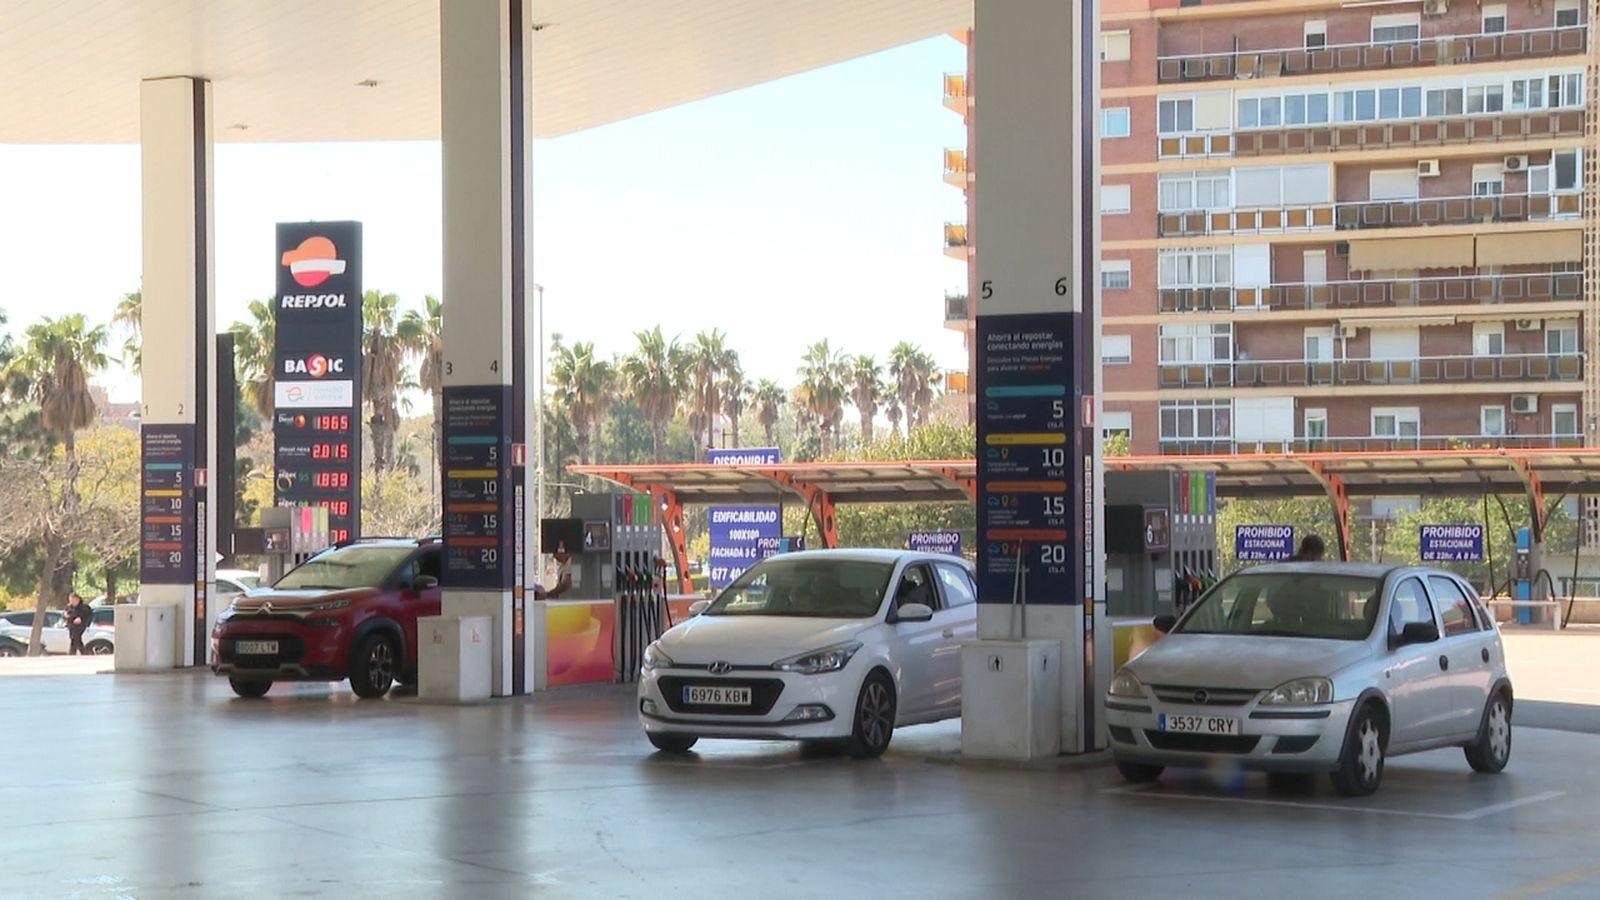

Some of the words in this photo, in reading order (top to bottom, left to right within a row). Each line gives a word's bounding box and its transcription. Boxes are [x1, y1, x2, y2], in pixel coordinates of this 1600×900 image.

[981, 280, 993, 299] 5
[1055, 277, 1067, 296] 6
[281, 294, 346, 308] REPSOL
[987, 333, 1011, 342] Ahorra
[1013, 332, 1020, 341] al
[1022, 331, 1053, 342] repostar
[987, 342, 1030, 351] conectando
[285, 355, 343, 374] BASIC
[446, 362, 453, 375] 3
[490, 360, 498, 374] 4
[144, 404, 149, 415] 1
[178, 403, 184, 415] 2
[1052, 400, 1064, 419] 5
[489, 446, 497, 461] 5
[1042, 448, 1064, 467] 10
[176, 471, 182, 483] 5
[483, 480, 497, 495] 10
[171, 498, 182, 510] 10
[1043, 496, 1065, 515] 15
[483, 514, 497, 529] 15
[713, 511, 776, 523] EDIFICABILIDAD
[171, 524, 182, 536] 15
[1147, 524, 1153, 543] 6
[1238, 527, 1291, 538] PROHIBIDO
[1423, 526, 1480, 538] PROHIBIDO
[266, 538, 272, 549] 2
[585, 532, 592, 545] 4
[911, 533, 959, 544] PROHIBIDO
[1244, 539, 1285, 548] ESTACIONAR
[1430, 539, 1473, 548] ESTACIONAR
[169, 551, 182, 563] 20
[481, 548, 497, 563] 20
[711, 547, 743, 558] FACHADA
[1041, 545, 1065, 563] 20
[1239, 551, 1249, 559] DE
[1269, 551, 1274, 559] A
[1423, 552, 1435, 560] DE
[1456, 552, 1462, 560] A
[712, 567, 728, 580] 677
[692, 688, 720, 702] 6976
[725, 689, 748, 703] KBW
[1170, 716, 1202, 731] 3537
[1208, 718, 1234, 732] CRY
